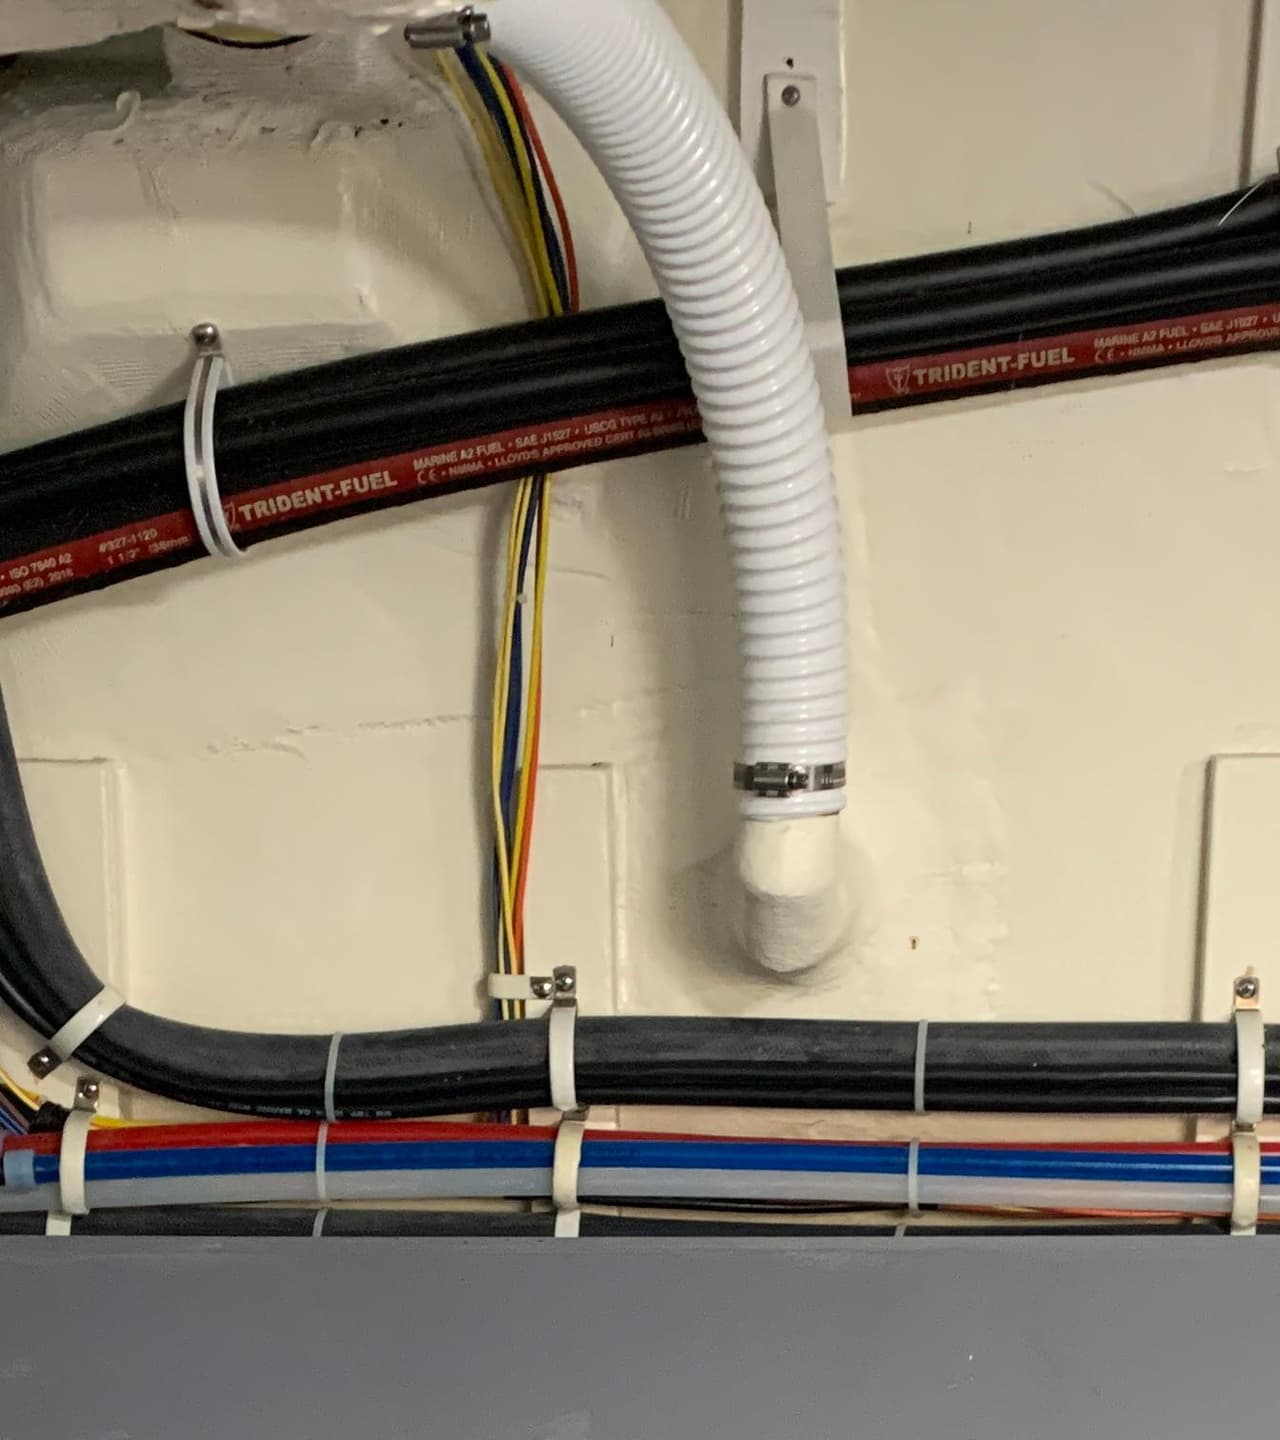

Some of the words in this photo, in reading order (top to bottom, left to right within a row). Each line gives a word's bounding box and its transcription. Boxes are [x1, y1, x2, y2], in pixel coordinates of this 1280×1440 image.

[1093, 332, 1139, 348] MARINE
[1141, 329, 1157, 343] A2
[1158, 325, 1188, 339] FUEL
[913, 346, 1075, 386] TRIDENT-FUEL
[412, 450, 458, 470] MARINE
[460, 447, 474, 460] A2
[475, 441, 504, 456] FUEL
[514, 433, 538, 449] SAE
[541, 436, 603, 457] APPROVED
[238, 469, 399, 523] TRIDENT-FUEL
[8, 565, 30, 579] ISO
[57, 552, 73, 565] A2
